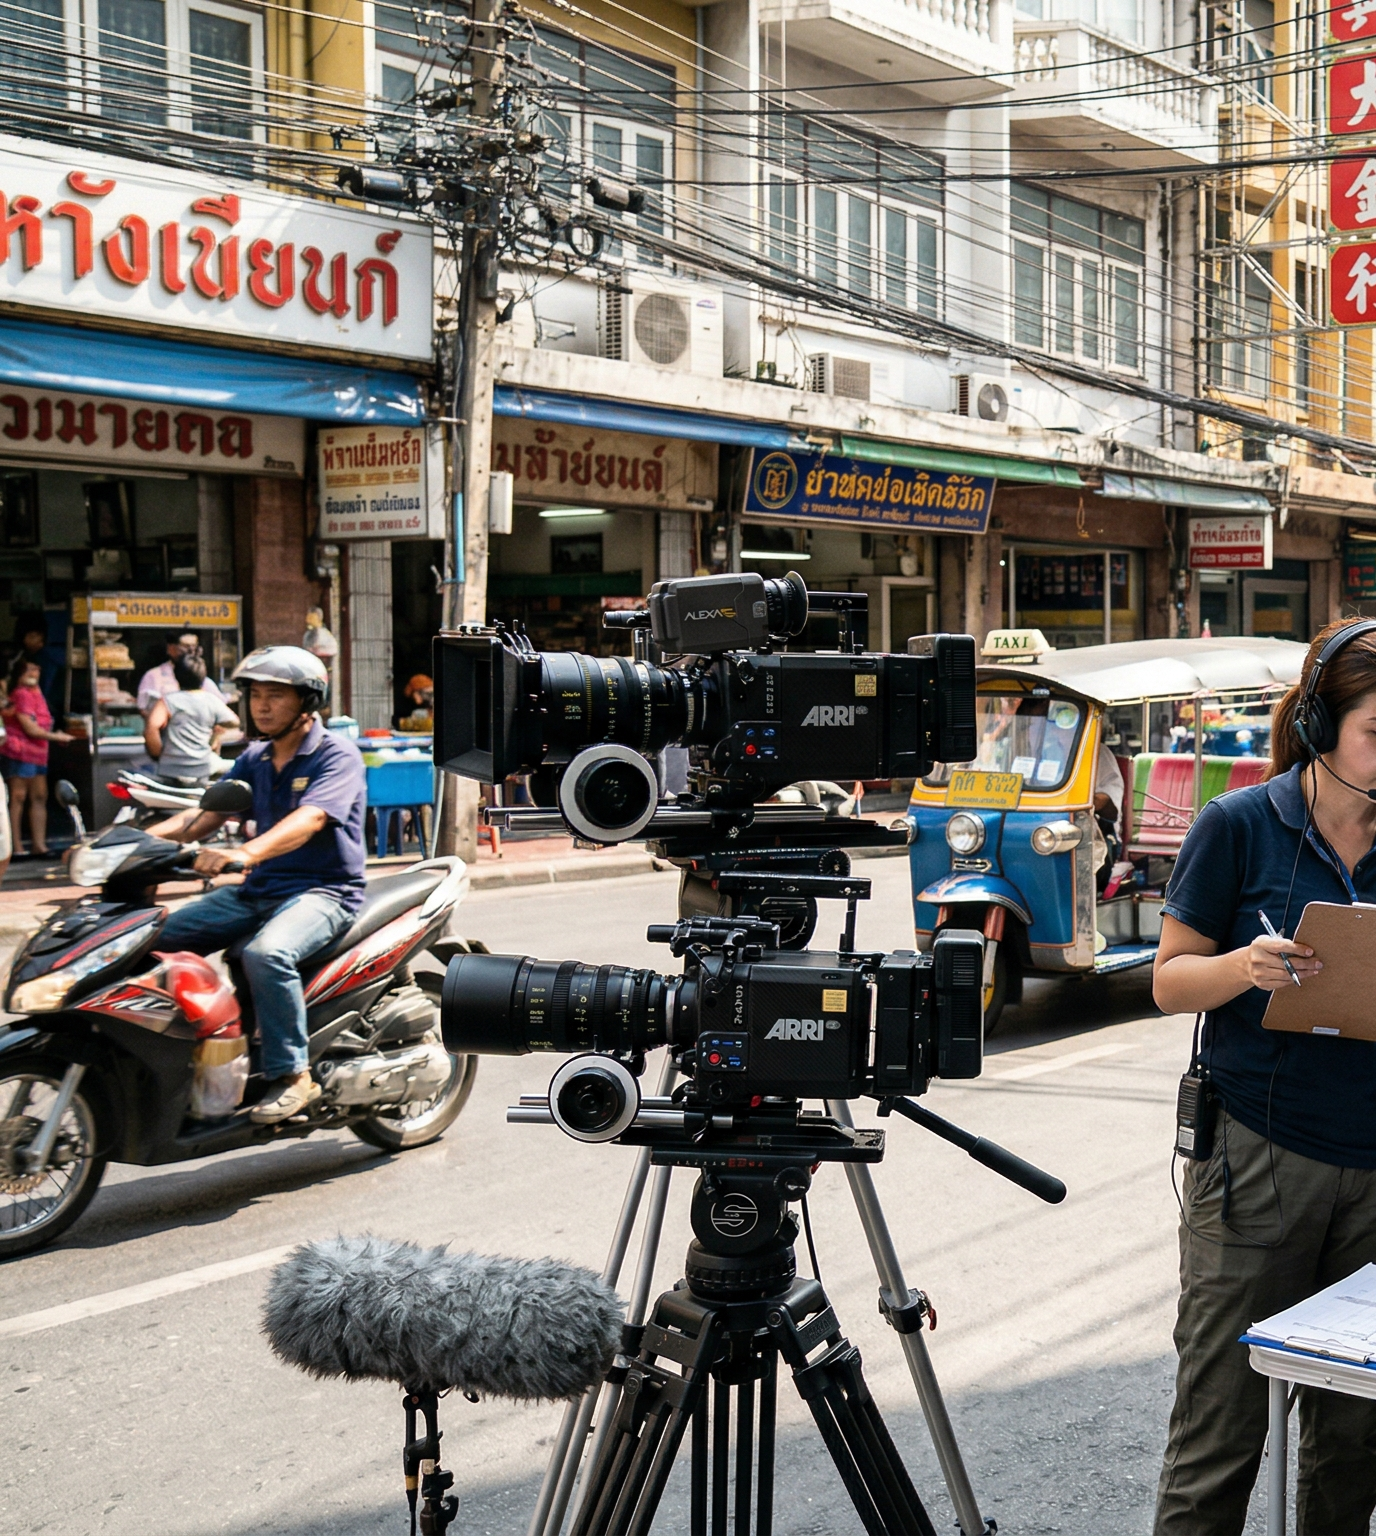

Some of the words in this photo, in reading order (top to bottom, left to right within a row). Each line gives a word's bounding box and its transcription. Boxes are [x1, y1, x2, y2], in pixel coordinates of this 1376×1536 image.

[994, 636, 1029, 648] TAXI
[800, 705, 855, 726] ARRI
[764, 1018, 824, 1041] ARRI
